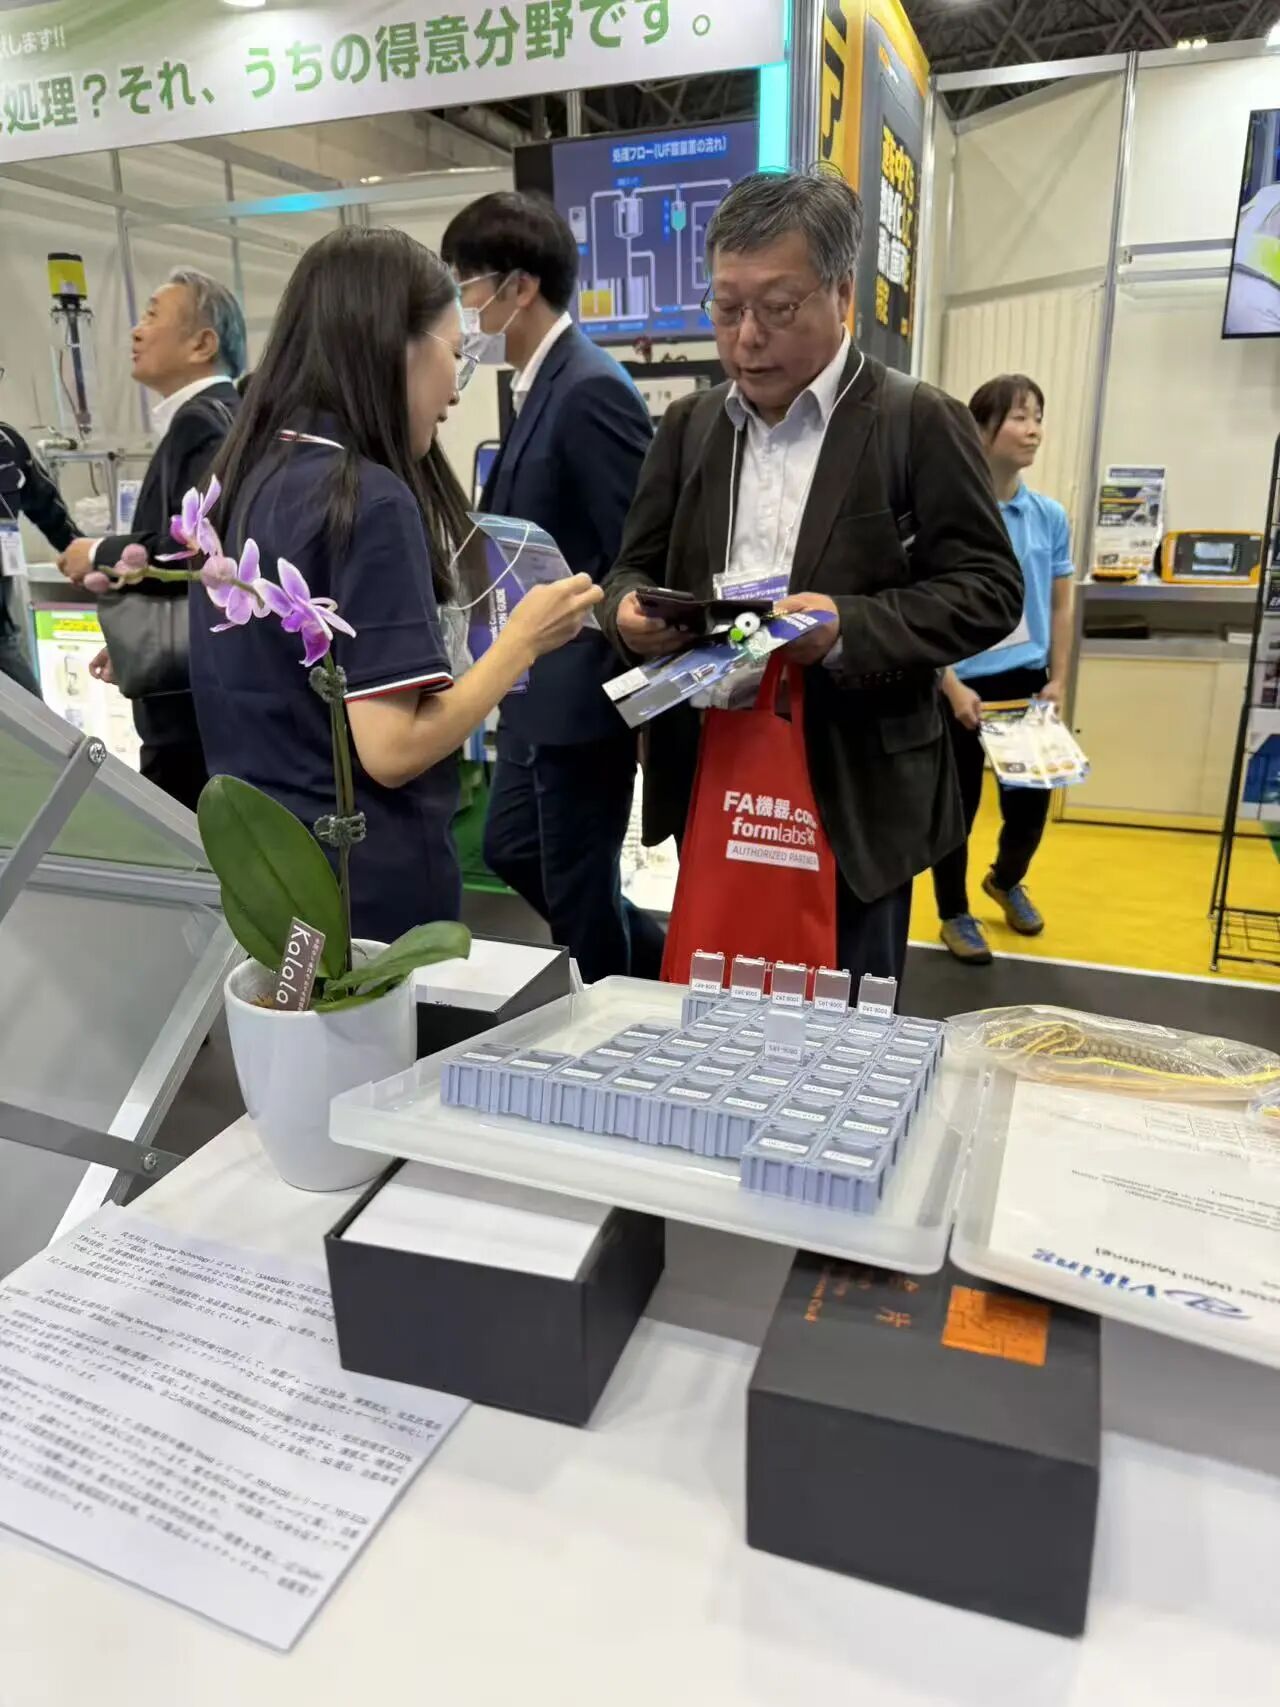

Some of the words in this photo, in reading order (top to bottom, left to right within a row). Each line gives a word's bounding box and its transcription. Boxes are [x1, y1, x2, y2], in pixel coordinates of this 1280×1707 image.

[0, 0, 711, 135] 処理？それ、うちの得意分野です。
[732, 816, 807, 845] formlabs
[276, 924, 311, 1004] Kalala
